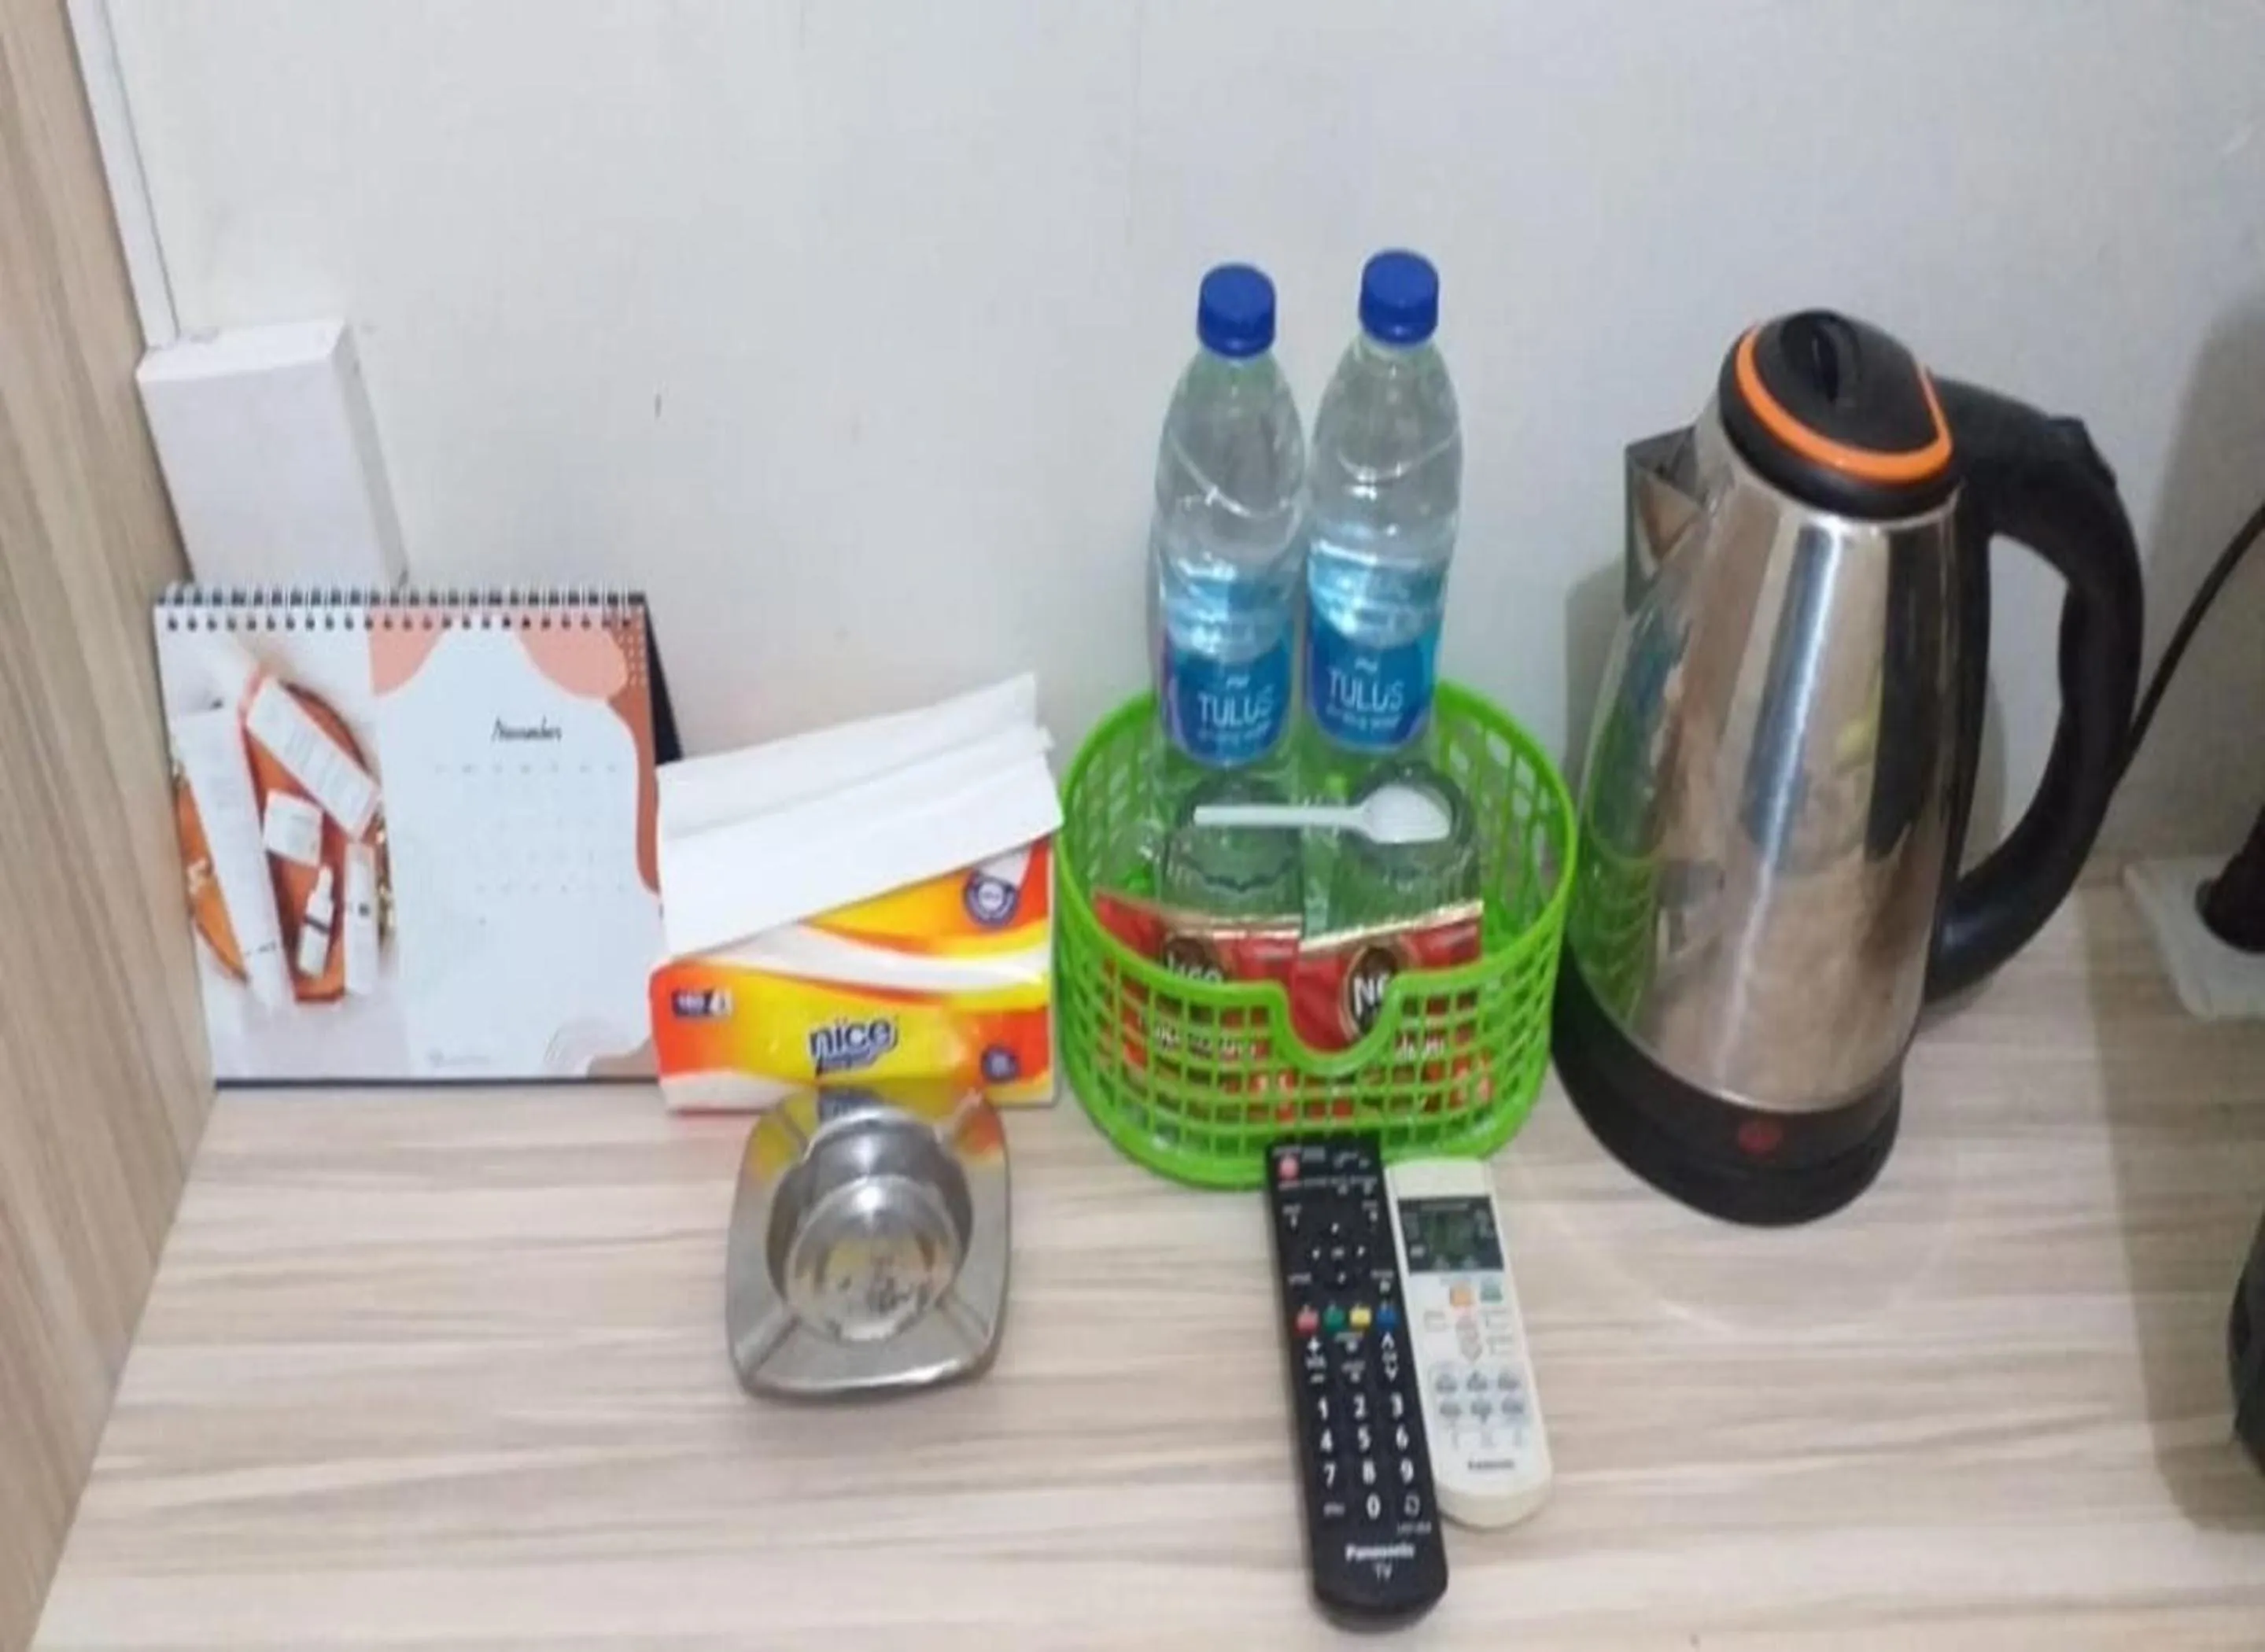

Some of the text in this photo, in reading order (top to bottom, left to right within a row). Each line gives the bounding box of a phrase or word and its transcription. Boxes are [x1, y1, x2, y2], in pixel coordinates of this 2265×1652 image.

[809, 1017, 892, 1059] nice
[1317, 1396, 1329, 1419] 1
[1353, 1393, 1367, 1418] 2
[1320, 1425, 1408, 1451] 4 5 6
[1322, 1458, 1414, 1488] 7 8 9
